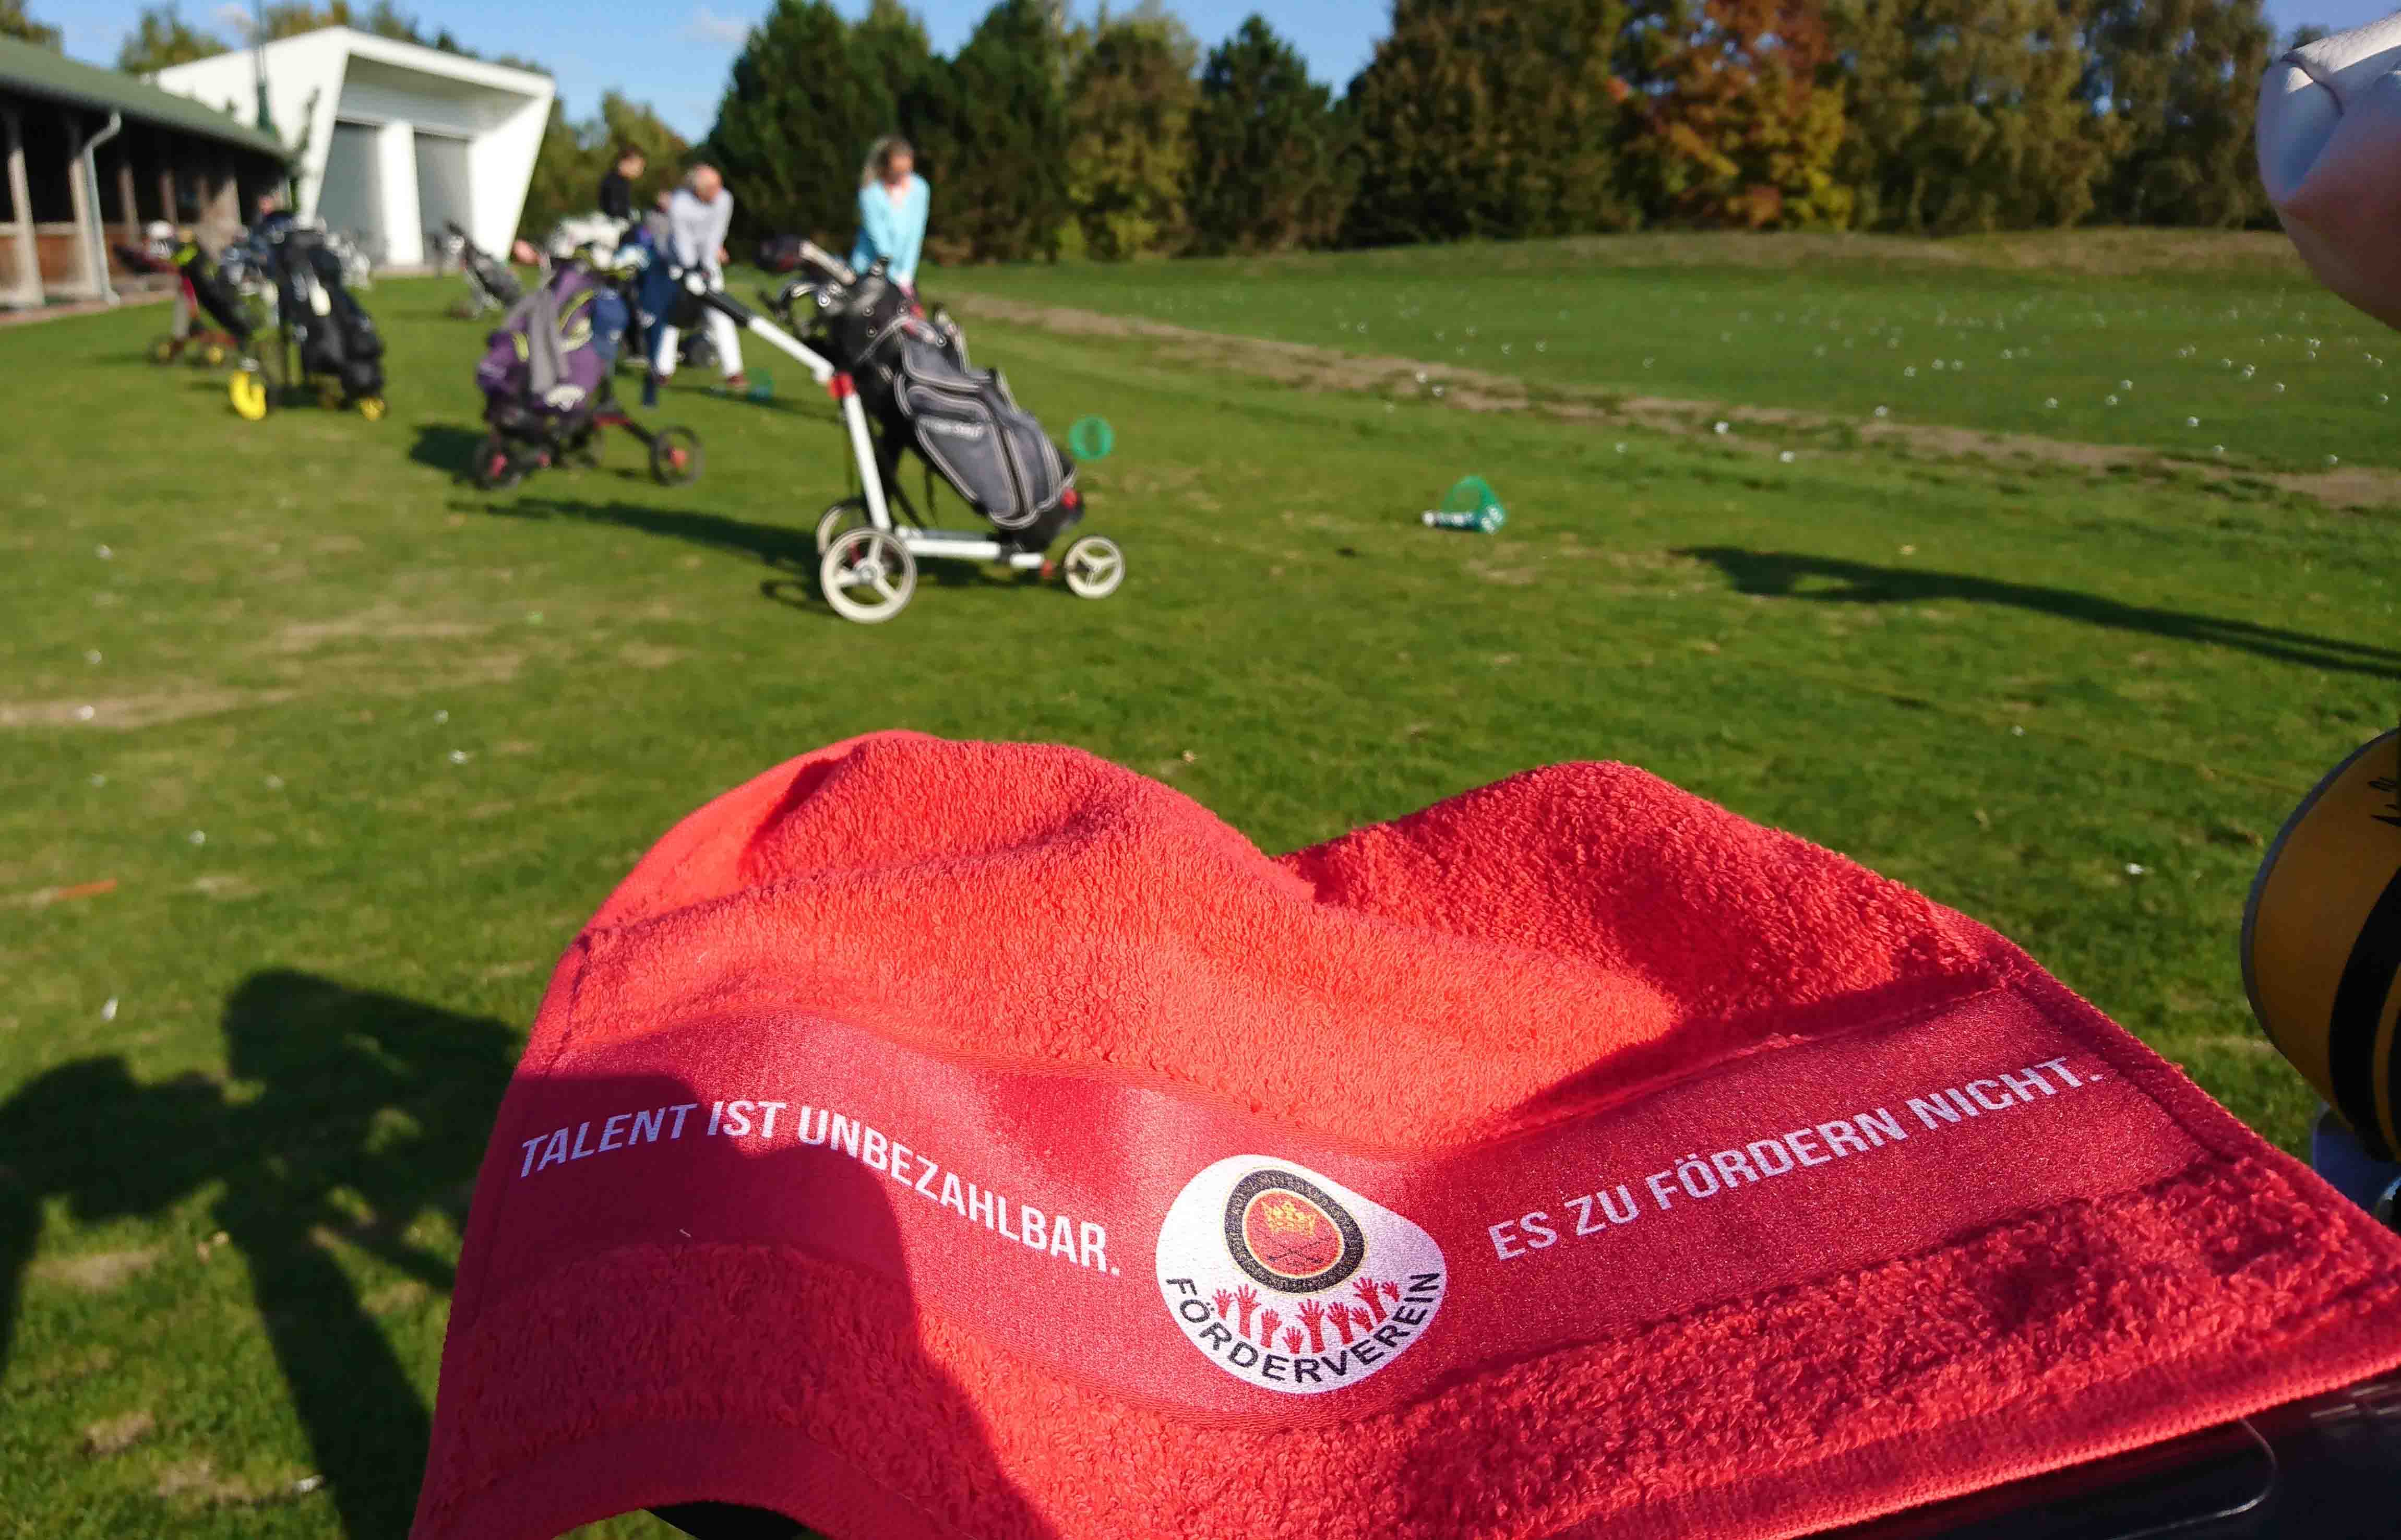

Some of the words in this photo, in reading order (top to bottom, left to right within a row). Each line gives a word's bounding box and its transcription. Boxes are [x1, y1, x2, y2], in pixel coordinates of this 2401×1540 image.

[521, 1103, 698, 1178] TALENT
[706, 1100, 786, 1139] IST
[798, 1106, 1120, 1277] UNBEZAHLBAR.
[1487, 1211, 1558, 1261] ES
[1563, 1184, 1641, 1237] ZU
[1644, 1107, 1908, 1210] FÖRDERN
[1906, 1056, 2104, 1130] NICHT.
[1166, 1272, 1440, 1383] FÖRDERVEREIN
